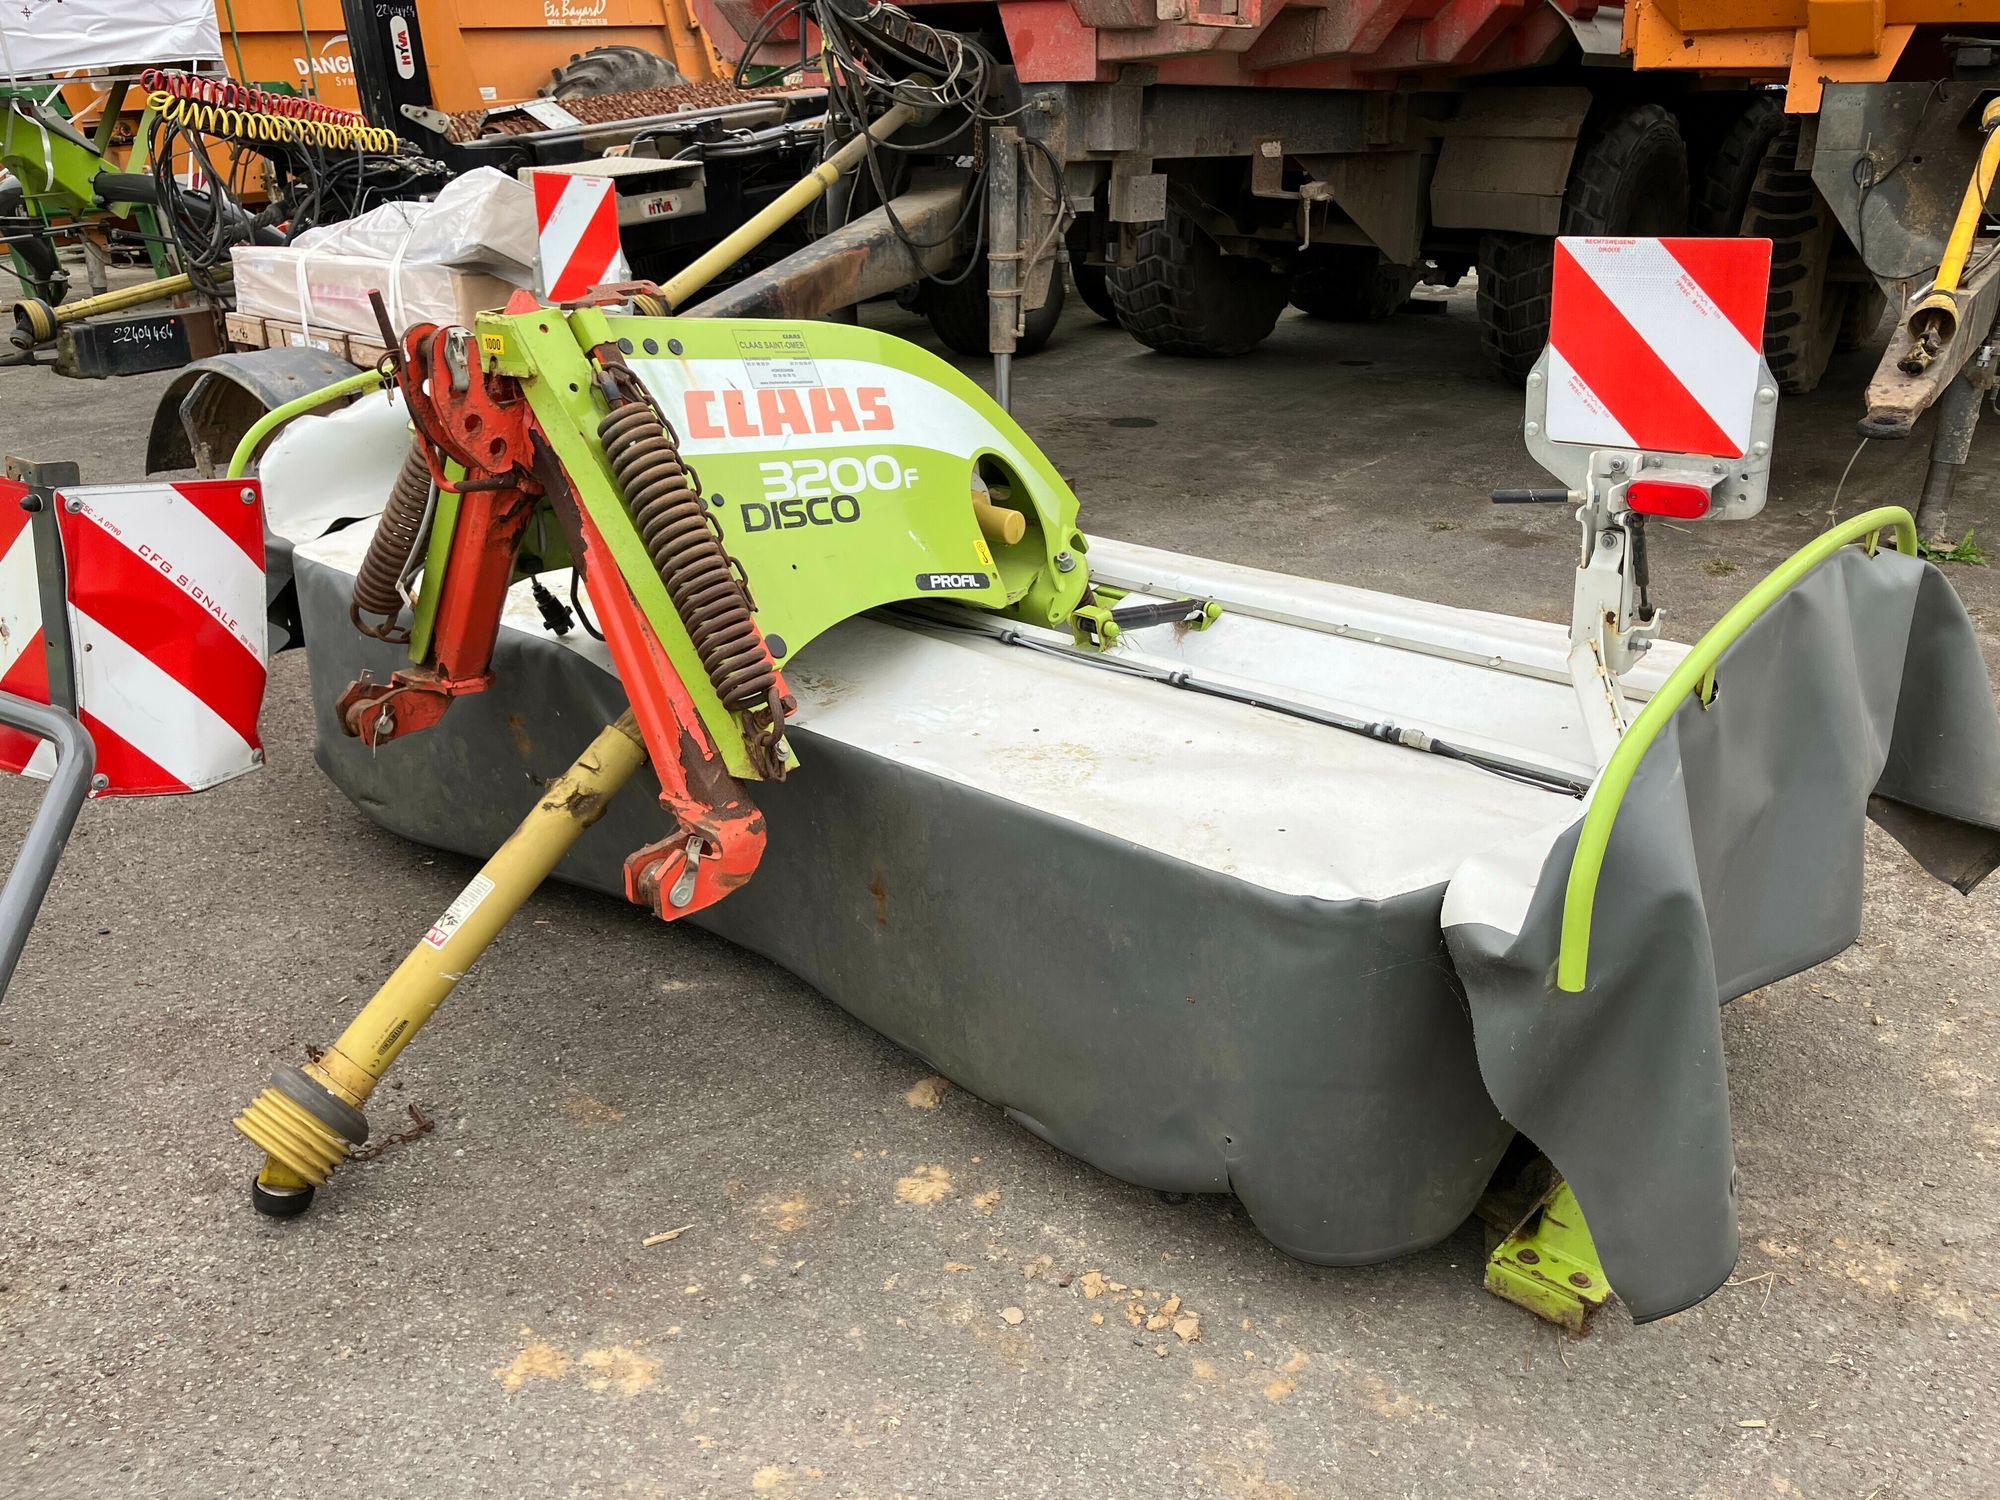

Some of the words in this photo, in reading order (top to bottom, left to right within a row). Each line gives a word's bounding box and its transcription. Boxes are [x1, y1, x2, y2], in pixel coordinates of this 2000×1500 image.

[396, 30, 411, 65] HYVA
[648, 198, 673, 215] HYVA
[112, 324, 173, 344] 22404464
[485, 337, 501, 350] 1000
[740, 341, 763, 350] CLAAS
[764, 340, 806, 350] SAINT-OMER
[684, 387, 895, 439] CLAAS
[740, 495, 861, 533] DISCO
[138, 544, 173, 574] CFG
[930, 574, 980, 588] PROFIL
